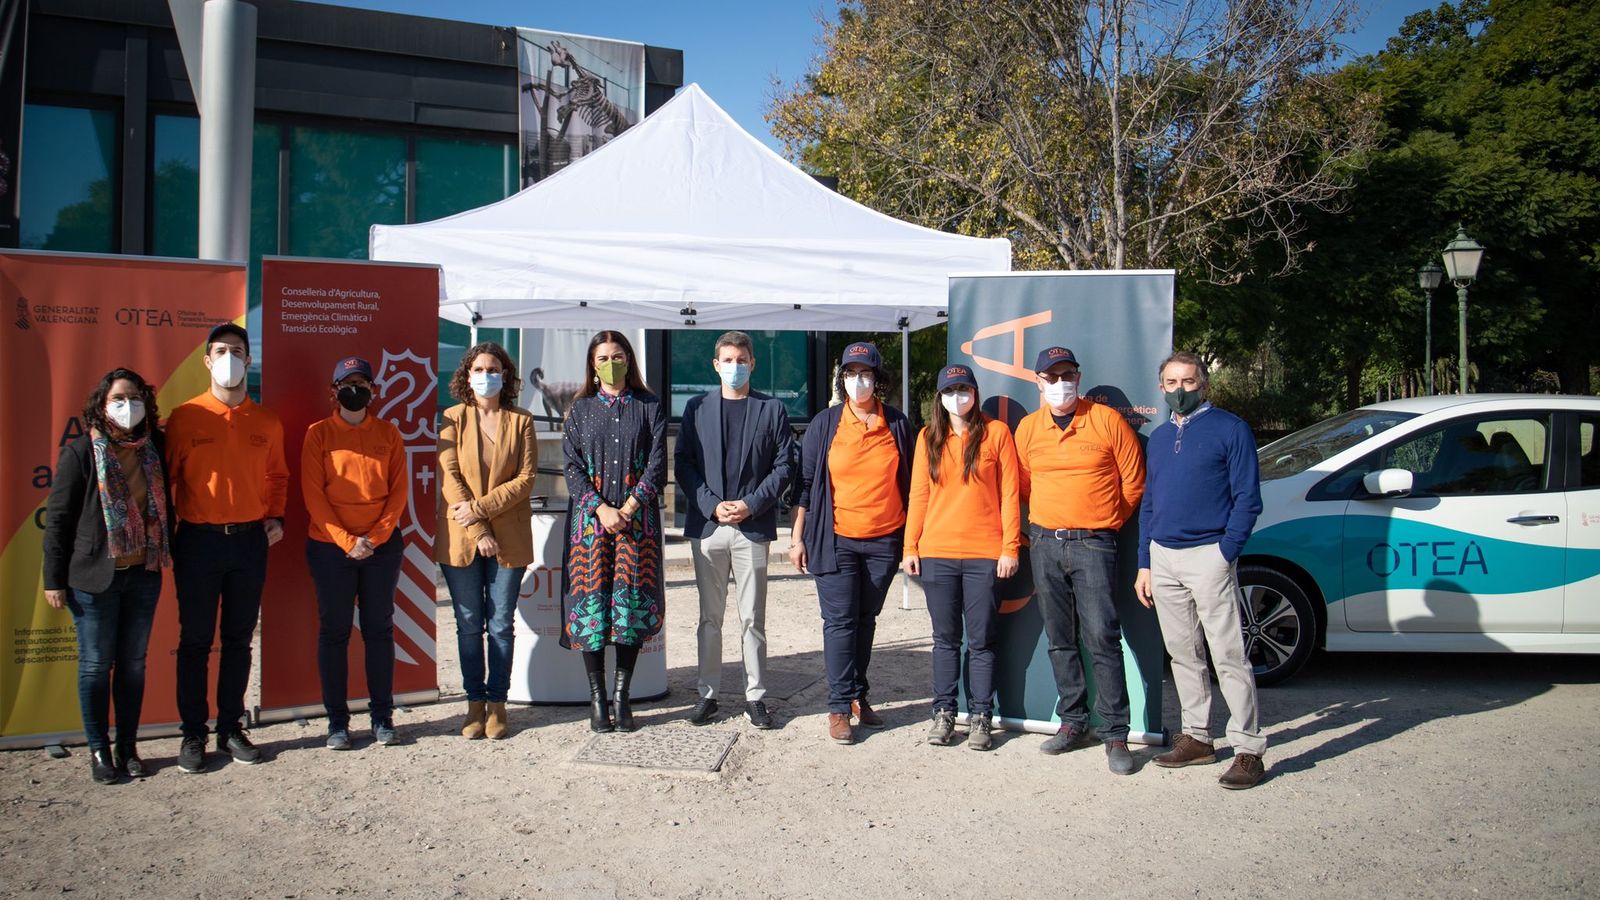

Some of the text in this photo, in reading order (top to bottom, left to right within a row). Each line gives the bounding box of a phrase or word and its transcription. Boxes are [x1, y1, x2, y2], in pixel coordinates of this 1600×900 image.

[281, 286, 381, 300] Conselleria d'Agricultura,
[33, 305, 99, 315] GENERALITAT
[281, 299, 380, 311] Desenvolupament Rural,
[34, 314, 98, 324] VALENCIANA
[115, 308, 173, 327] OTEA
[281, 312, 330, 322] Emergència
[331, 312, 368, 322] Climàtica
[281, 323, 358, 336] Transició Ecològica
[849, 346, 869, 354] OTEA
[946, 367, 967, 375] OTEA
[1366, 540, 1489, 578] OTEA
